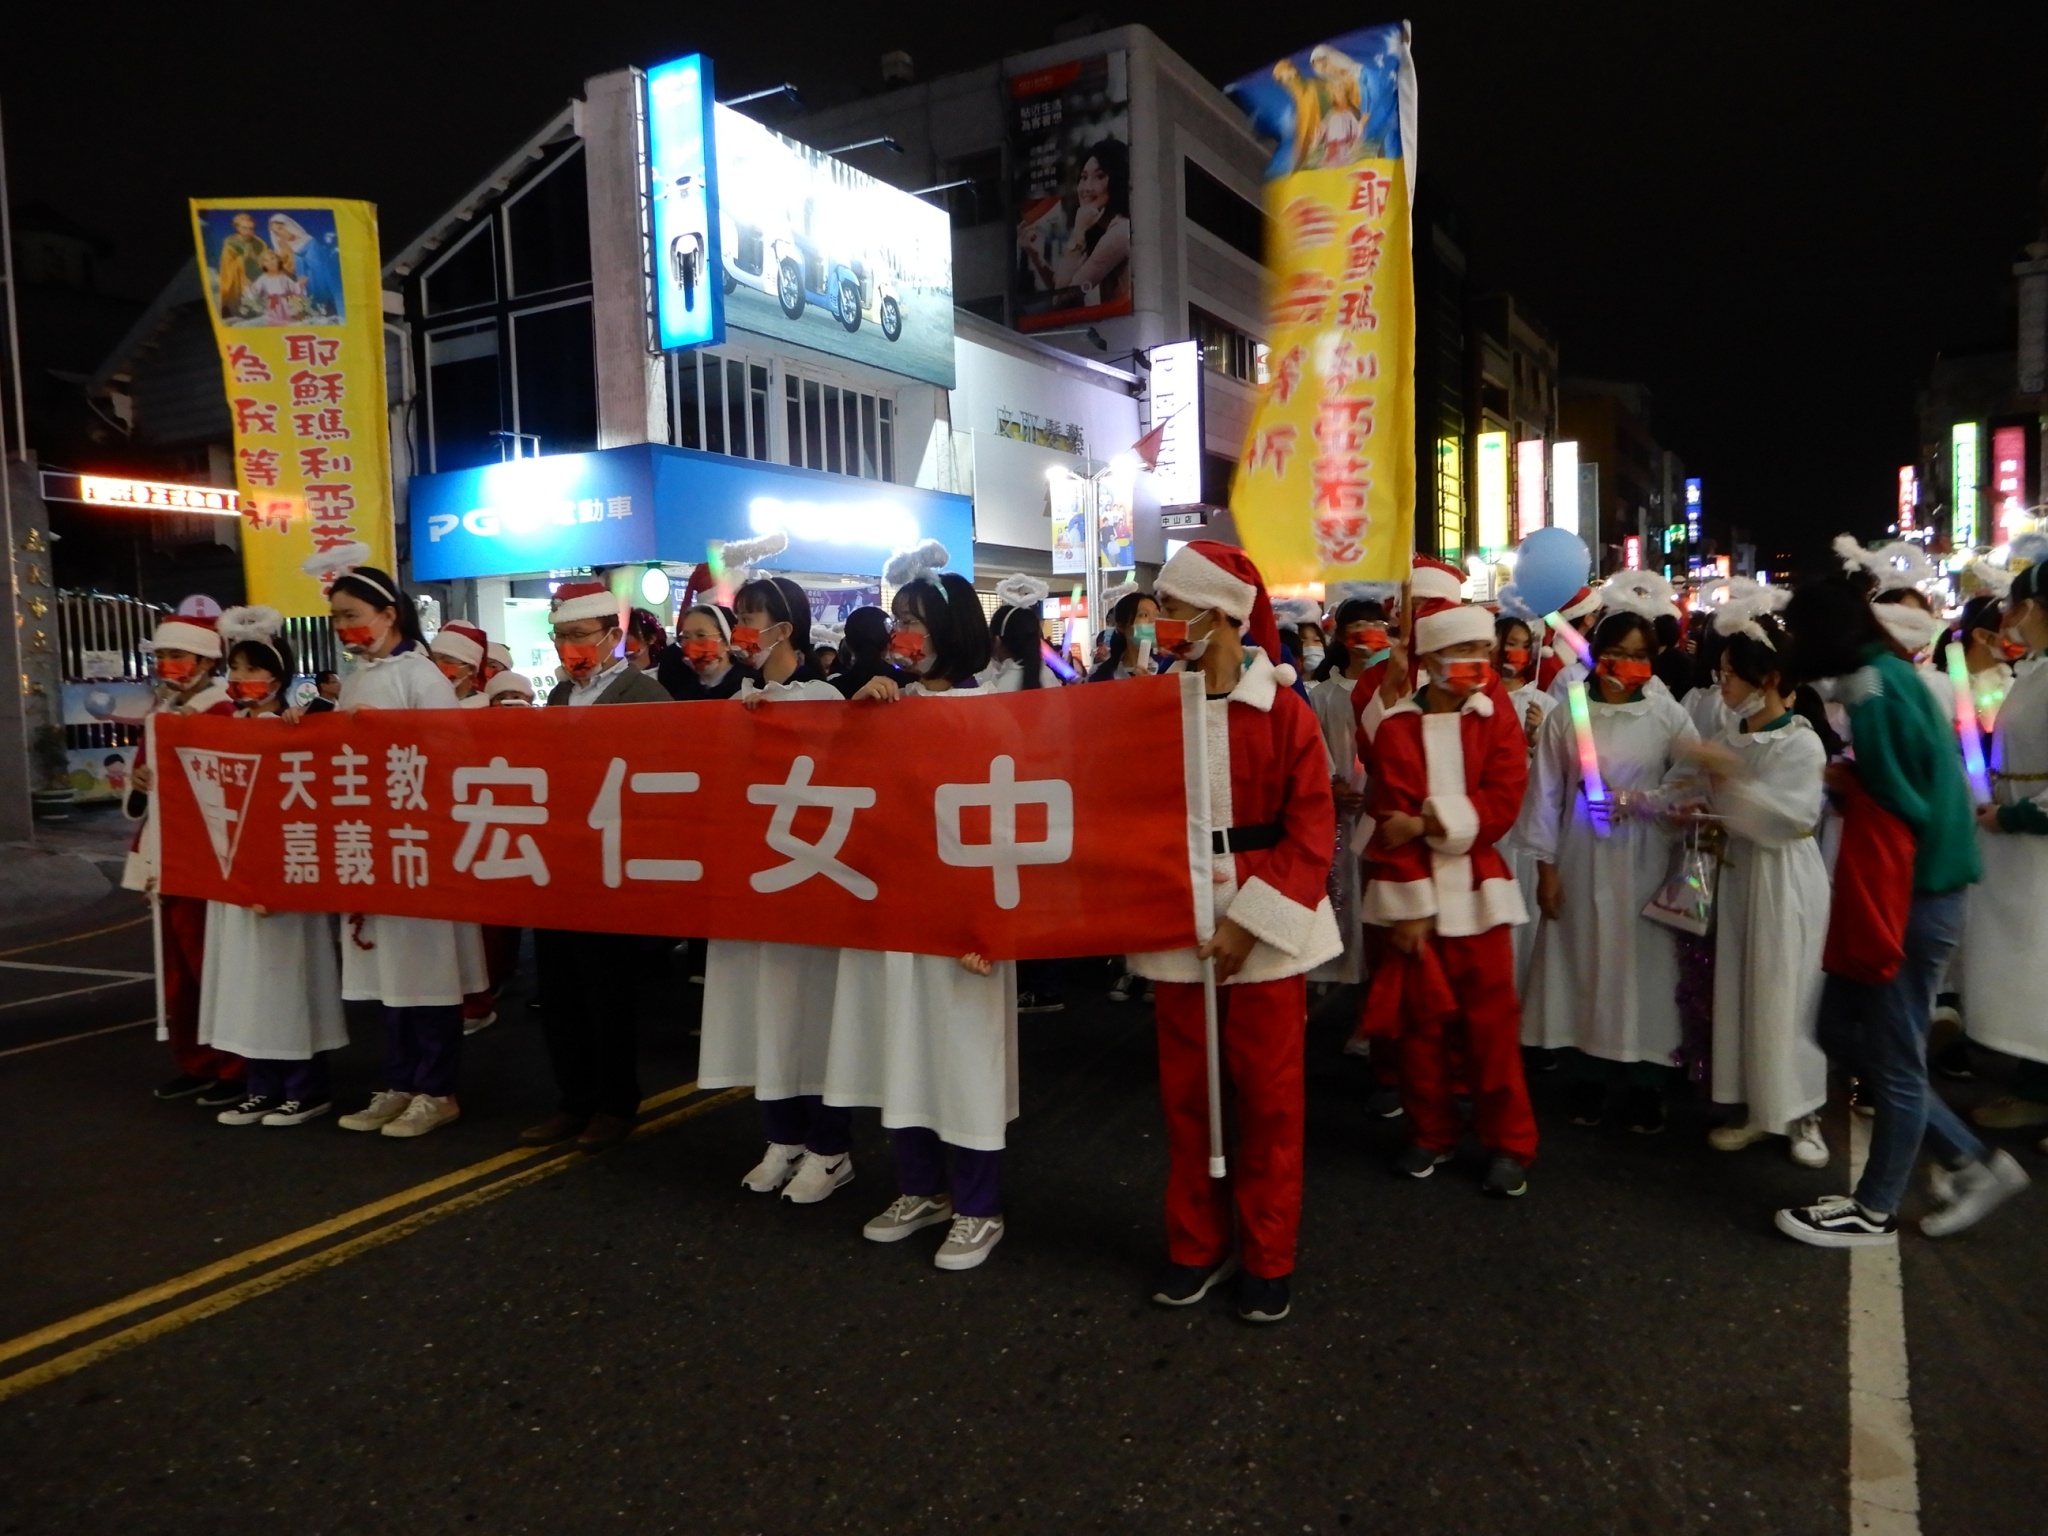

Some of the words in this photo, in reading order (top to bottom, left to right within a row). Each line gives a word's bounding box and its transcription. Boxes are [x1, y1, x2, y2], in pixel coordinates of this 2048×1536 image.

[227, 343, 289, 534] 為我等祈
[428, 506, 546, 543] PG
[1162, 514, 1193, 526] 中山店
[278, 743, 429, 811] 天主教
[282, 819, 430, 889] 嘉義市
[450, 754, 1075, 911] 宏仁女中
